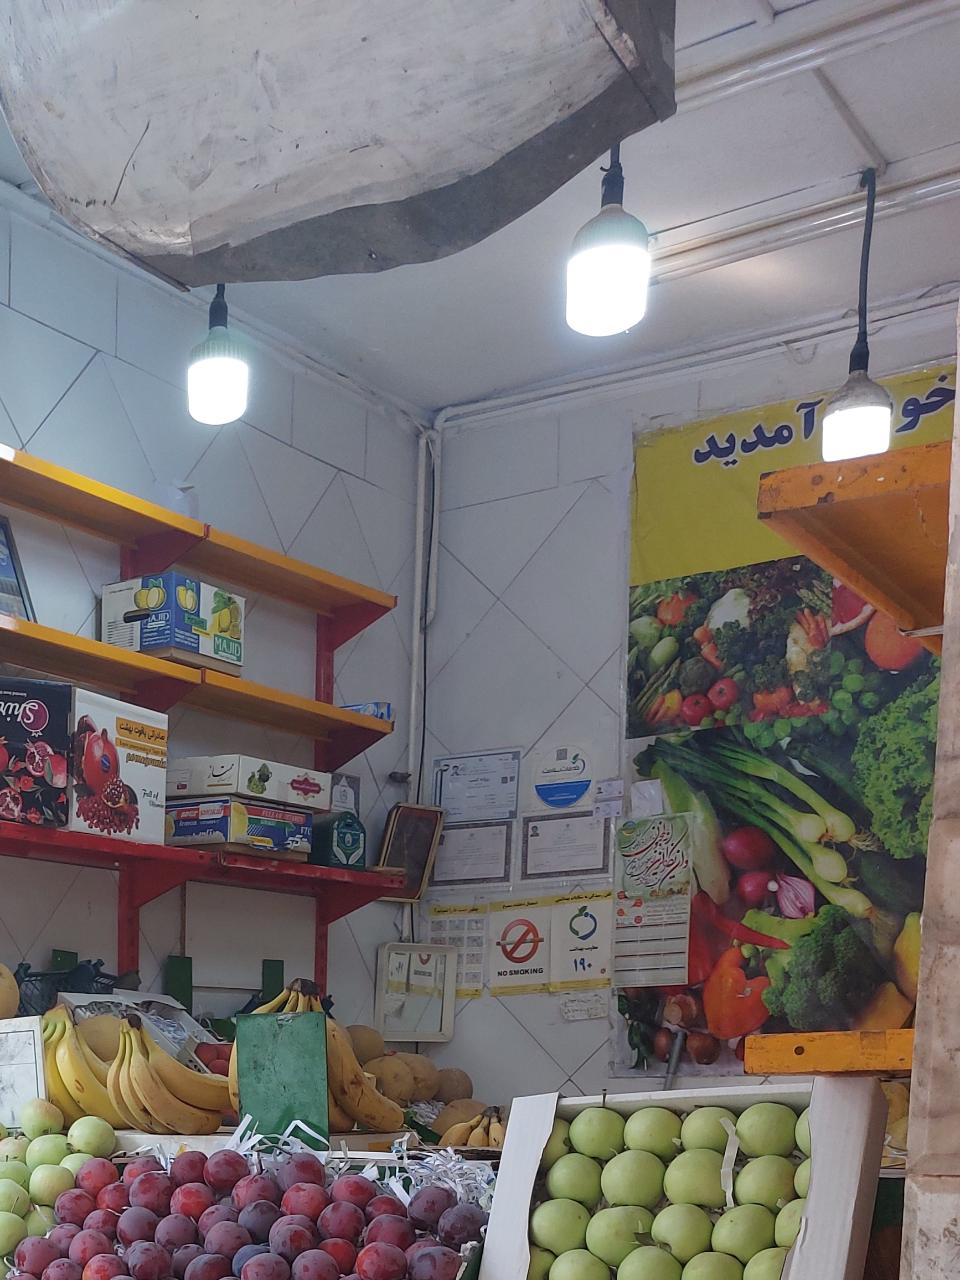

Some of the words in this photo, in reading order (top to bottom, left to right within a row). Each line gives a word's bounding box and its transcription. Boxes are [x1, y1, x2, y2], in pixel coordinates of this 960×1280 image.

[693, 397, 825, 467] آمدید
[215, 635, 241, 657] MAJID
[497, 969, 508, 977] NO
[509, 967, 544, 977] SMOKING
[573, 957, 593, 972] ۱۹۰
